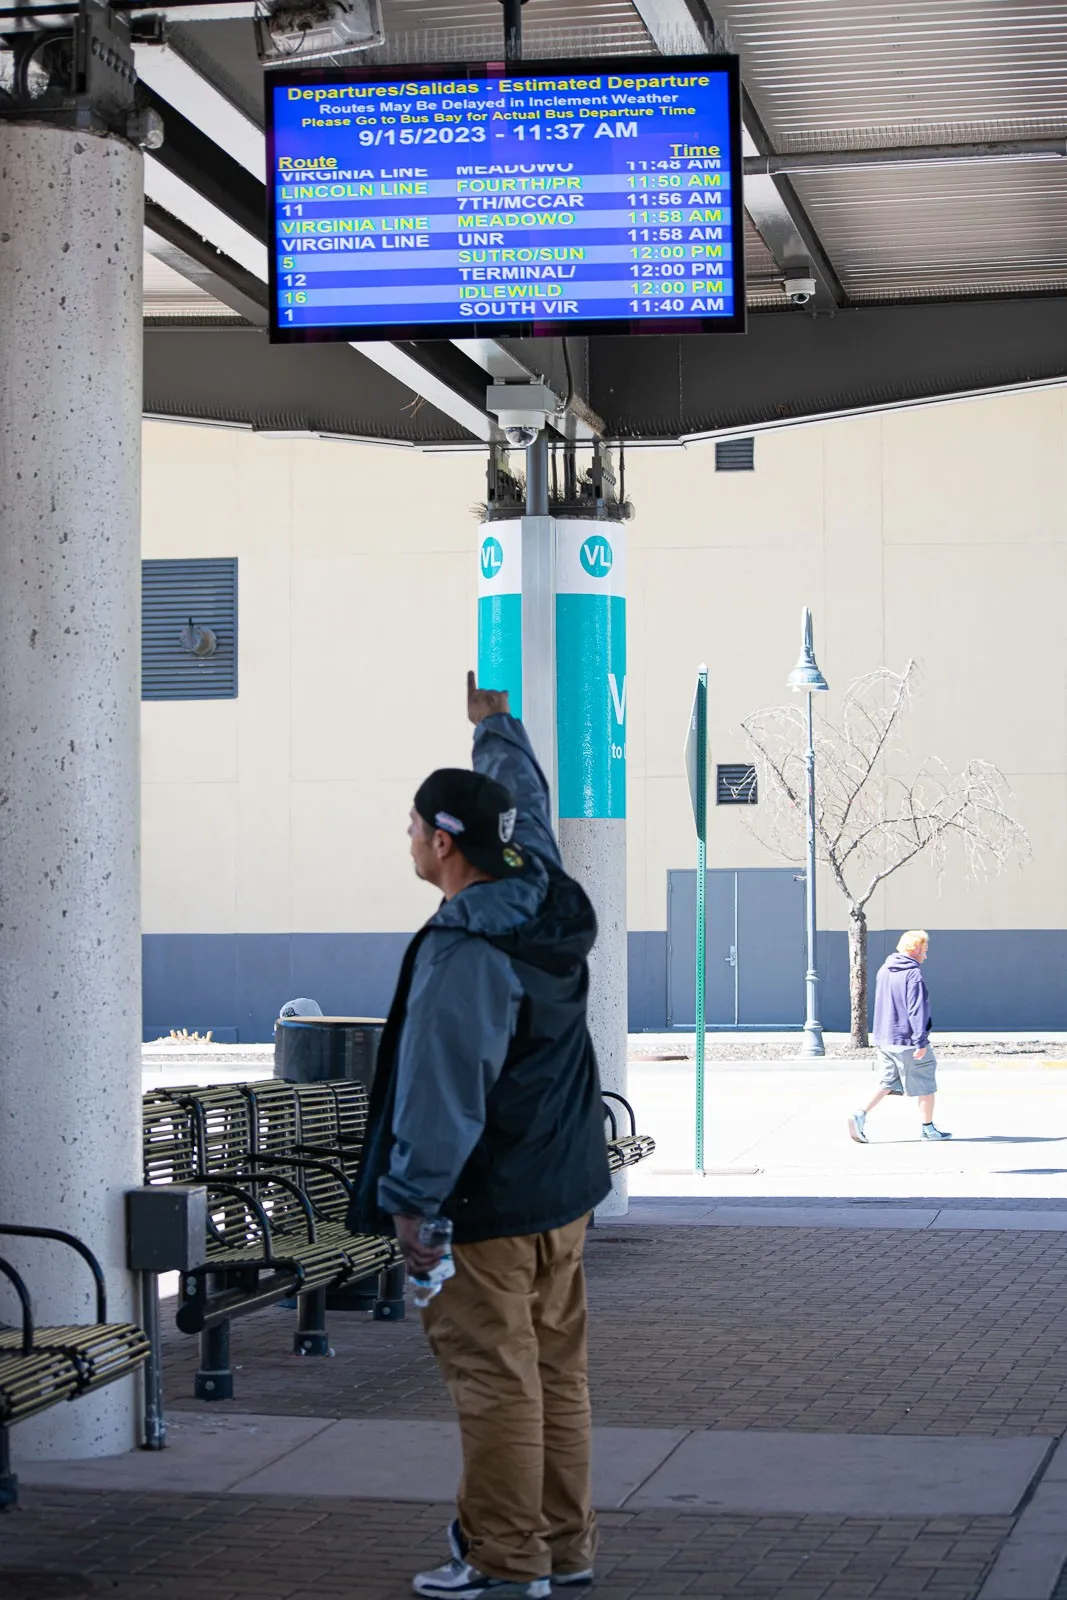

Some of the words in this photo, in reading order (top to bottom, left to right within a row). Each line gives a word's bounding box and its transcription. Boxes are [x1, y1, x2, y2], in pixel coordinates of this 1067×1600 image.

[287, 81, 479, 102] Departures/Salidas
[499, 77, 601, 92] Estimated
[608, 75, 710, 91] Departure
[320, 103, 375, 114] Routes
[380, 102, 412, 114] May
[416, 100, 437, 110] Be
[442, 98, 504, 112] Delayed
[510, 98, 524, 107] in
[529, 95, 608, 107] Inclement
[612, 93, 679, 104] Weather
[302, 117, 351, 127] Please
[356, 116, 377, 125] Go
[381, 115, 396, 124] to
[401, 114, 429, 123] Bus
[434, 113, 462, 124] Bay
[467, 112, 487, 121] for
[492, 111, 540, 120] Actual
[545, 110, 574, 119] Bus
[579, 107, 654, 119] Departure
[659, 106, 696, 115] Time
[358, 127, 486, 147] 9/15/2023
[513, 123, 585, 140] 11:37
[594, 121, 638, 139] AM
[278, 156, 338, 169] Route
[670, 144, 720, 157] Time
[687, 160, 721, 169] AM
[282, 184, 374, 199] LINCOLN
[381, 182, 428, 196] LINE
[457, 176, 582, 192] FOURTH/PR
[626, 175, 682, 188] 11:50
[688, 174, 722, 187] AM
[282, 204, 303, 216] 11
[457, 194, 584, 210] 7TH/MCCAR
[627, 193, 682, 206] 11:56
[688, 192, 722, 204] AM
[282, 219, 375, 234] VIRGINIA
[381, 217, 429, 231] LINE
[458, 212, 575, 228] MEADOWO
[627, 211, 683, 224] 11:58
[688, 209, 722, 222] AM
[282, 236, 376, 251] VIRGINIA
[382, 235, 430, 249] LINE
[458, 233, 504, 246] UNR
[628, 228, 683, 241] 11:58
[688, 227, 723, 240] AM
[282, 257, 294, 269] 5
[458, 248, 586, 263] SUTRO/SUN
[630, 246, 685, 259] 12:00
[691, 245, 723, 257] PM
[284, 274, 307, 287] 12
[458, 266, 576, 281] TERMINAL/
[630, 264, 685, 277] 12:00
[692, 262, 723, 276] PM
[284, 292, 307, 304] 16
[459, 284, 562, 299] IDLEWILD
[631, 281, 685, 294] 12:00
[692, 280, 724, 293] PM
[284, 309, 294, 321] 1
[459, 302, 536, 316] SOUTH
[542, 301, 579, 314] VIR
[630, 299, 684, 312] 11:40
[690, 298, 724, 311] AM
[481, 546, 502, 568] VL
[583, 544, 612, 568] VL
[612, 743, 622, 760] to
